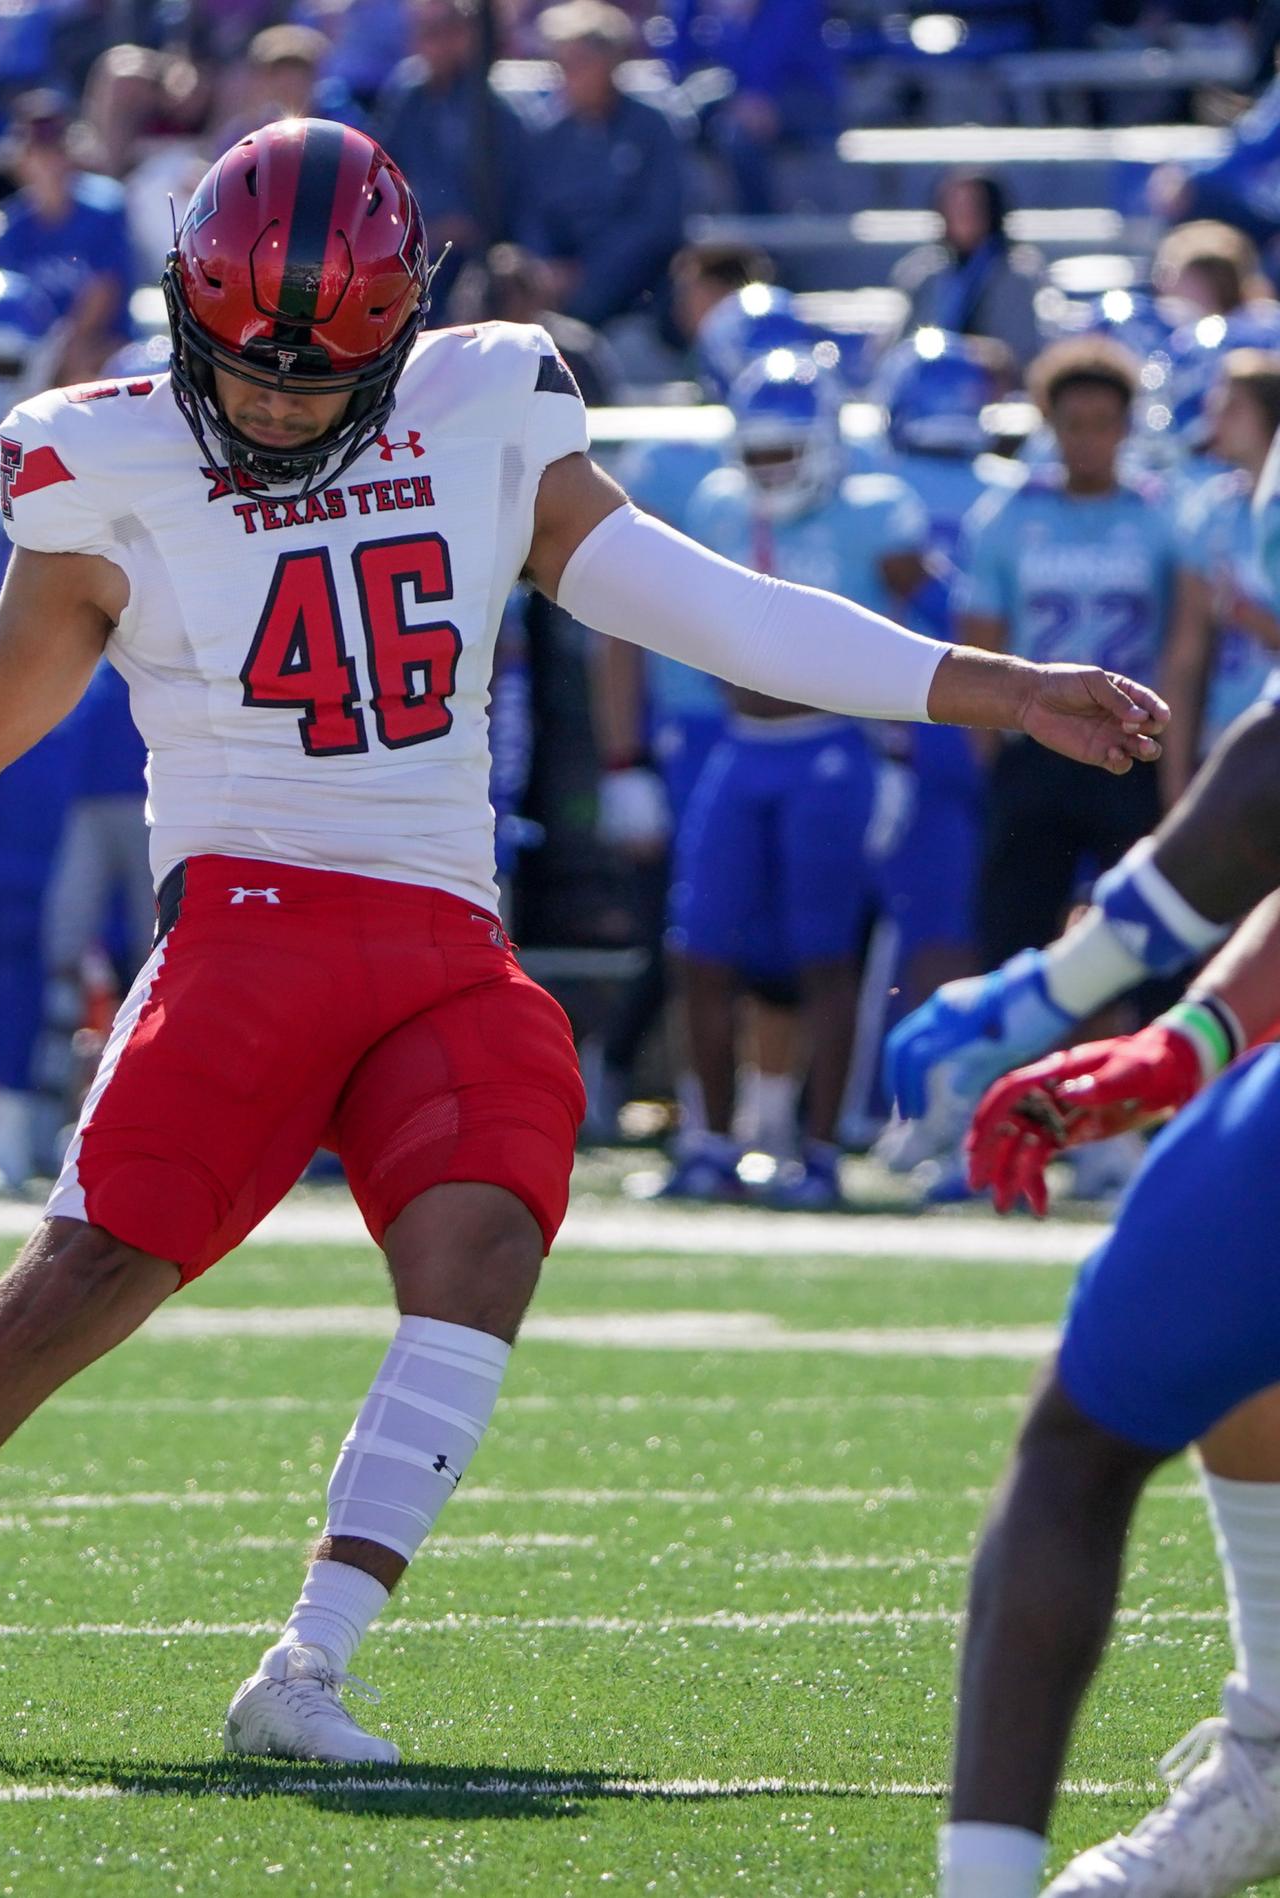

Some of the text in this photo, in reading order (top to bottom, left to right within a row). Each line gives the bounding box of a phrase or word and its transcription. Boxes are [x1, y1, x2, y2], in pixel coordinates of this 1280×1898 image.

[232, 475, 435, 534] TEXAS TECH
[240, 532, 462, 757] 46
